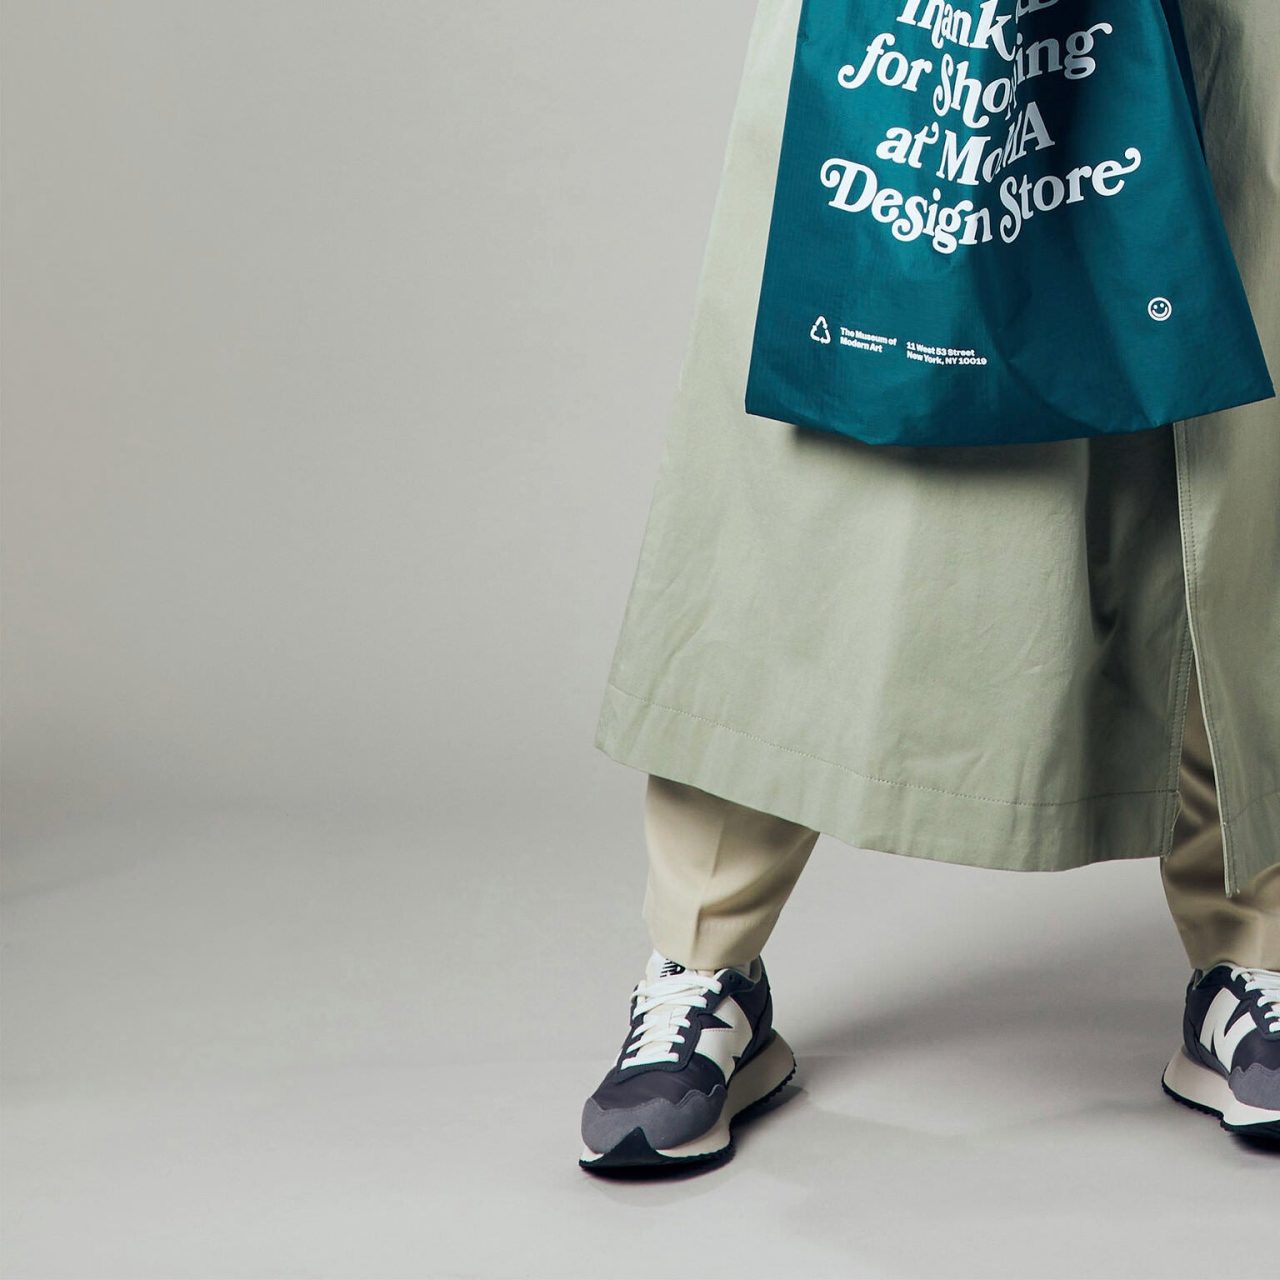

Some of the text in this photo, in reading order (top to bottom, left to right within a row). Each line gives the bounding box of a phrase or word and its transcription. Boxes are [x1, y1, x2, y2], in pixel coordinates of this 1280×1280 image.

[837, 23, 1113, 128] for Shoing
[876, 121, 939, 169] at
[820, 147, 1142, 255] Design Store
[840, 327, 898, 346] The Museum of
[840, 336, 883, 353] Modern Art
[906, 341, 975, 357] 11 West 53 Street
[907, 351, 987, 366] New York, NY 10019
